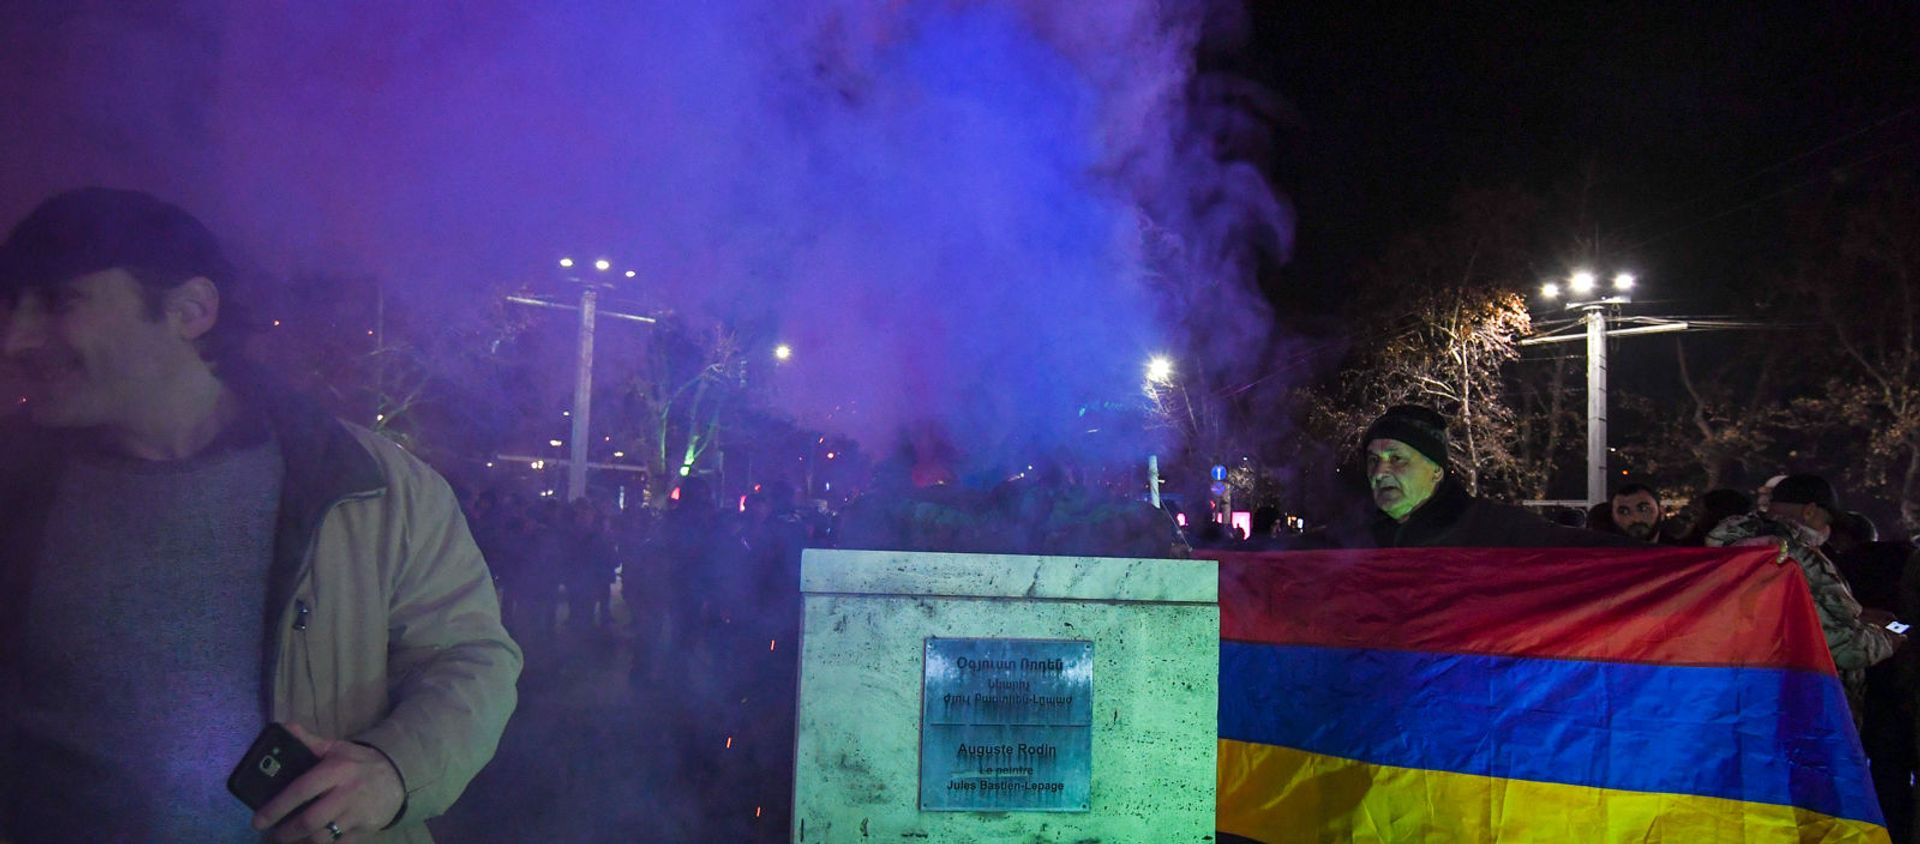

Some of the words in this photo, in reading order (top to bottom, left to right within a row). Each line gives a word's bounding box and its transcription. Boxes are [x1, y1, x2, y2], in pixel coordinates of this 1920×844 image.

[958, 743, 1013, 757] Auguste
[1018, 743, 1057, 756] Rodin
[979, 765, 993, 775] Le
[996, 765, 1034, 777] peintre
[947, 780, 977, 790] Jules
[980, 780, 1064, 792] Bastien-Lepage
